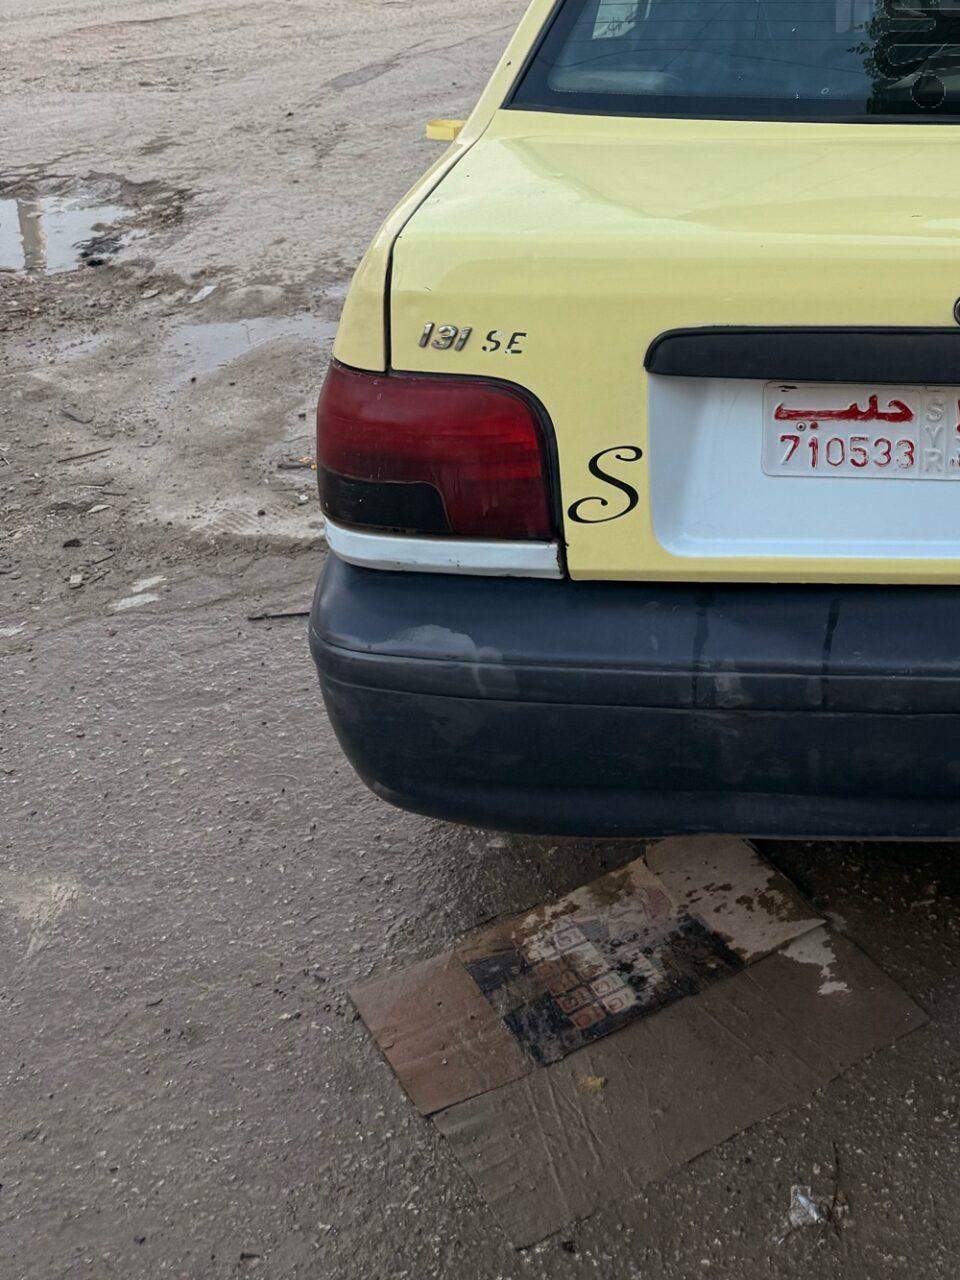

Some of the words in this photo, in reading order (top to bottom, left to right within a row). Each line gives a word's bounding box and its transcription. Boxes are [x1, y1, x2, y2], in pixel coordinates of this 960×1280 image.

[419, 321, 473, 352] 131
[481, 329, 528, 354] SE
[779, 434, 916, 470] 710533
[567, 445, 643, 524] S
